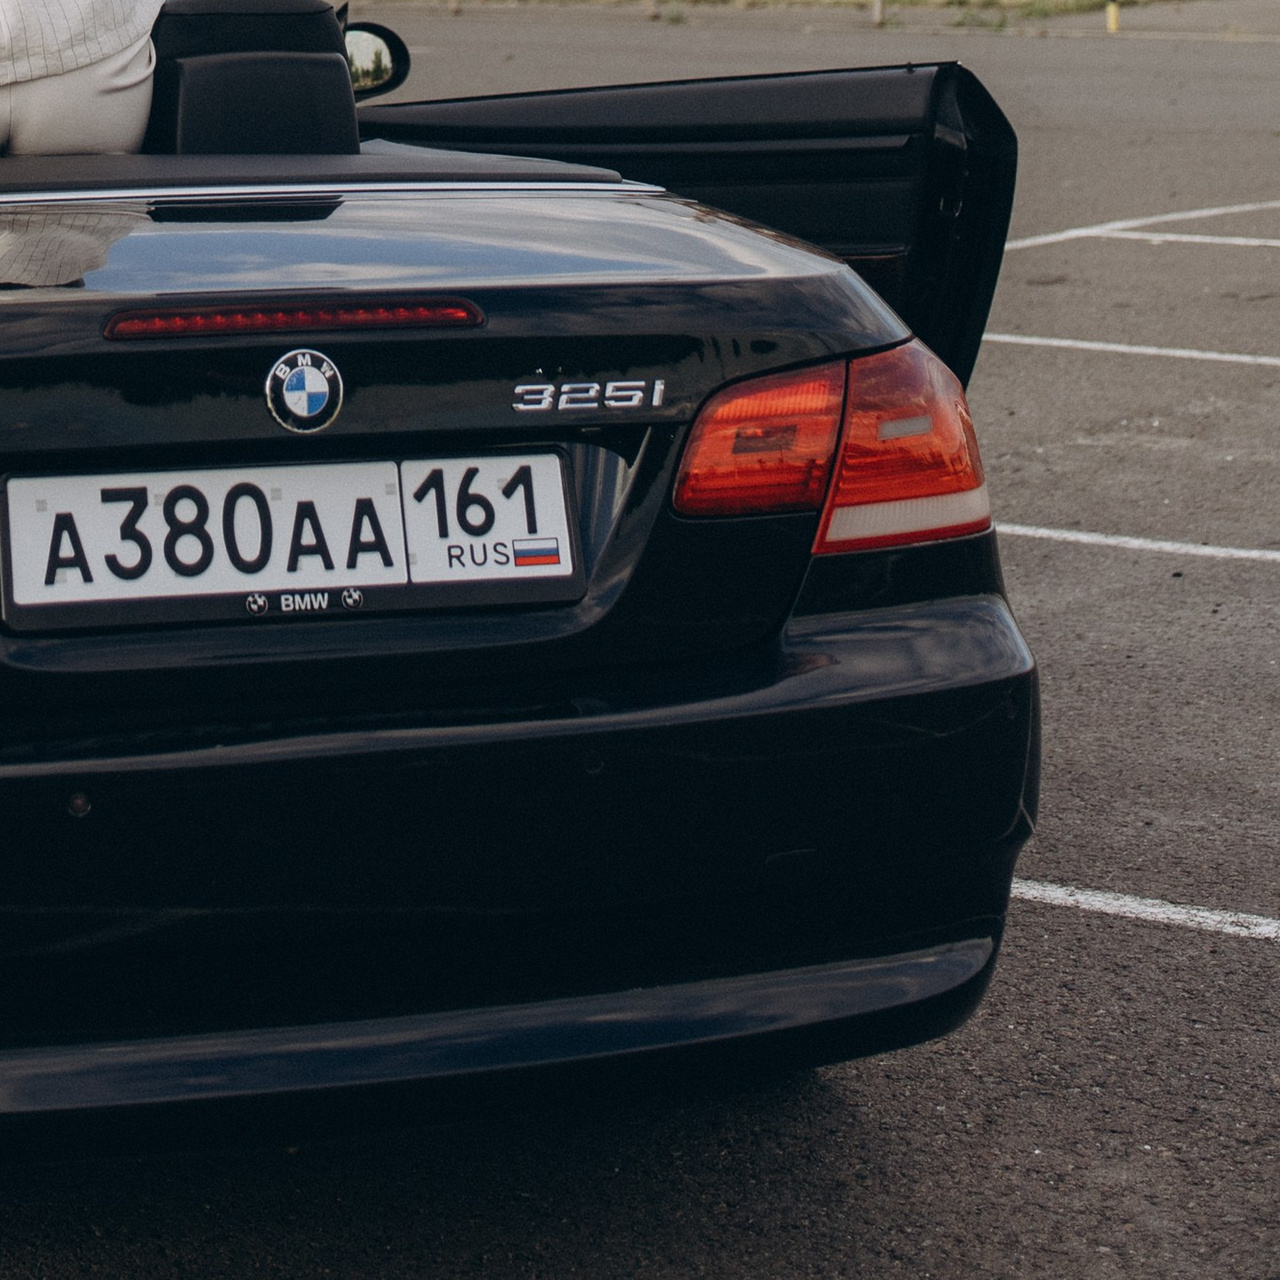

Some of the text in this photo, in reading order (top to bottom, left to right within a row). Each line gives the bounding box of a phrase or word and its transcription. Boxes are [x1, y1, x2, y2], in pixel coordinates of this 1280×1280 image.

[275, 353, 334, 380] BMW
[413, 465, 538, 539] 161
[447, 542, 510, 568] RUS
[280, 592, 328, 612] BMW
